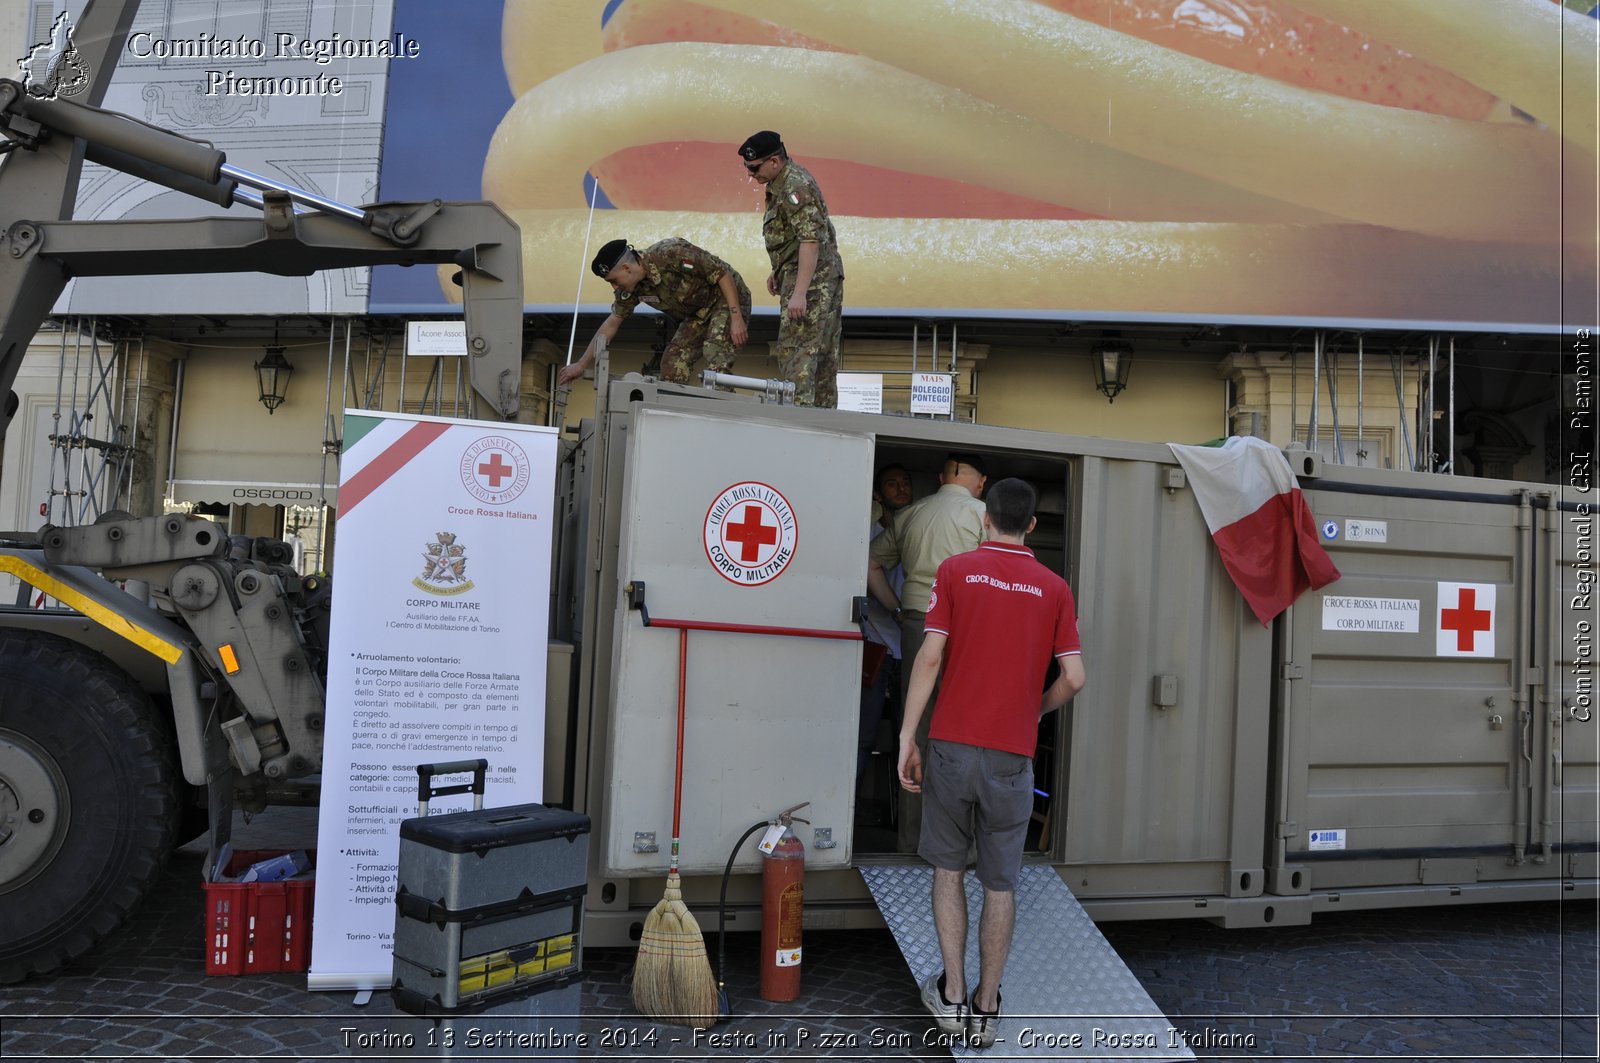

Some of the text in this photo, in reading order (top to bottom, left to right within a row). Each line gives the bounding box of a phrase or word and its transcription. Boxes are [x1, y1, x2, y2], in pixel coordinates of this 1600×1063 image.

[912, 385, 950, 394] NOLEGGIO
[912, 394, 950, 403] PONTEGGI
[233, 488, 313, 500] OSGOOD
[448, 506, 538, 520] Croce Rossa Italiana
[709, 486, 794, 531] CROCE ROSSA ITALIANA
[1364, 527, 1386, 537] RINA
[710, 545, 791, 581] CORPO MILITARE
[965, 574, 1043, 597] CROCE ROSSA ITALIANA
[406, 599, 480, 610] CORPO MILITARE
[1324, 597, 1418, 611] CROCE ROSSA ITALIANA
[405, 613, 438, 621] Ausiliario
[390, 621, 414, 629] Centro
[424, 623, 470, 632] Mobilitazione
[1336, 618, 1405, 630] CORPO MILITARE
[356, 653, 461, 664] Arruolamento volontario:
[356, 667, 520, 681] Il Corpo Militare della Croce Rossa Italiana
[375, 679, 402, 688] Corpo
[404, 680, 441, 688] ausiliario
[465, 682, 488, 690] Forze
[490, 683, 519, 691] Armate
[378, 689, 400, 697] Stato
[354, 699, 388, 707] volontari
[444, 703, 457, 711] per
[463, 704, 480, 712] gran
[486, 703, 506, 712] parte
[353, 711, 391, 719] congedo.
[361, 721, 387, 729] diretto
[389, 721, 400, 729] ad
[402, 722, 440, 730] assolvere
[442, 723, 471, 732] compiti
[474, 723, 481, 731] in
[483, 724, 508, 733] tempo
[352, 732, 378, 740] guerra
[402, 732, 421, 741] gravi
[424, 734, 468, 743] emergenze
[482, 735, 507, 744] tempo
[510, 735, 518, 743] di
[351, 742, 374, 750] pace,
[376, 741, 406, 750] nonché
[475, 744, 505, 752] relativo.
[350, 763, 387, 771] Possono
[350, 774, 390, 783] categorie:
[444, 775, 473, 783] medici,
[348, 805, 398, 814] Sottufficiali
[347, 817, 386, 825] infermieri,
[347, 828, 388, 836] inservienti.
[356, 874, 390, 883] Impiego
[355, 896, 391, 905] Impieghi
